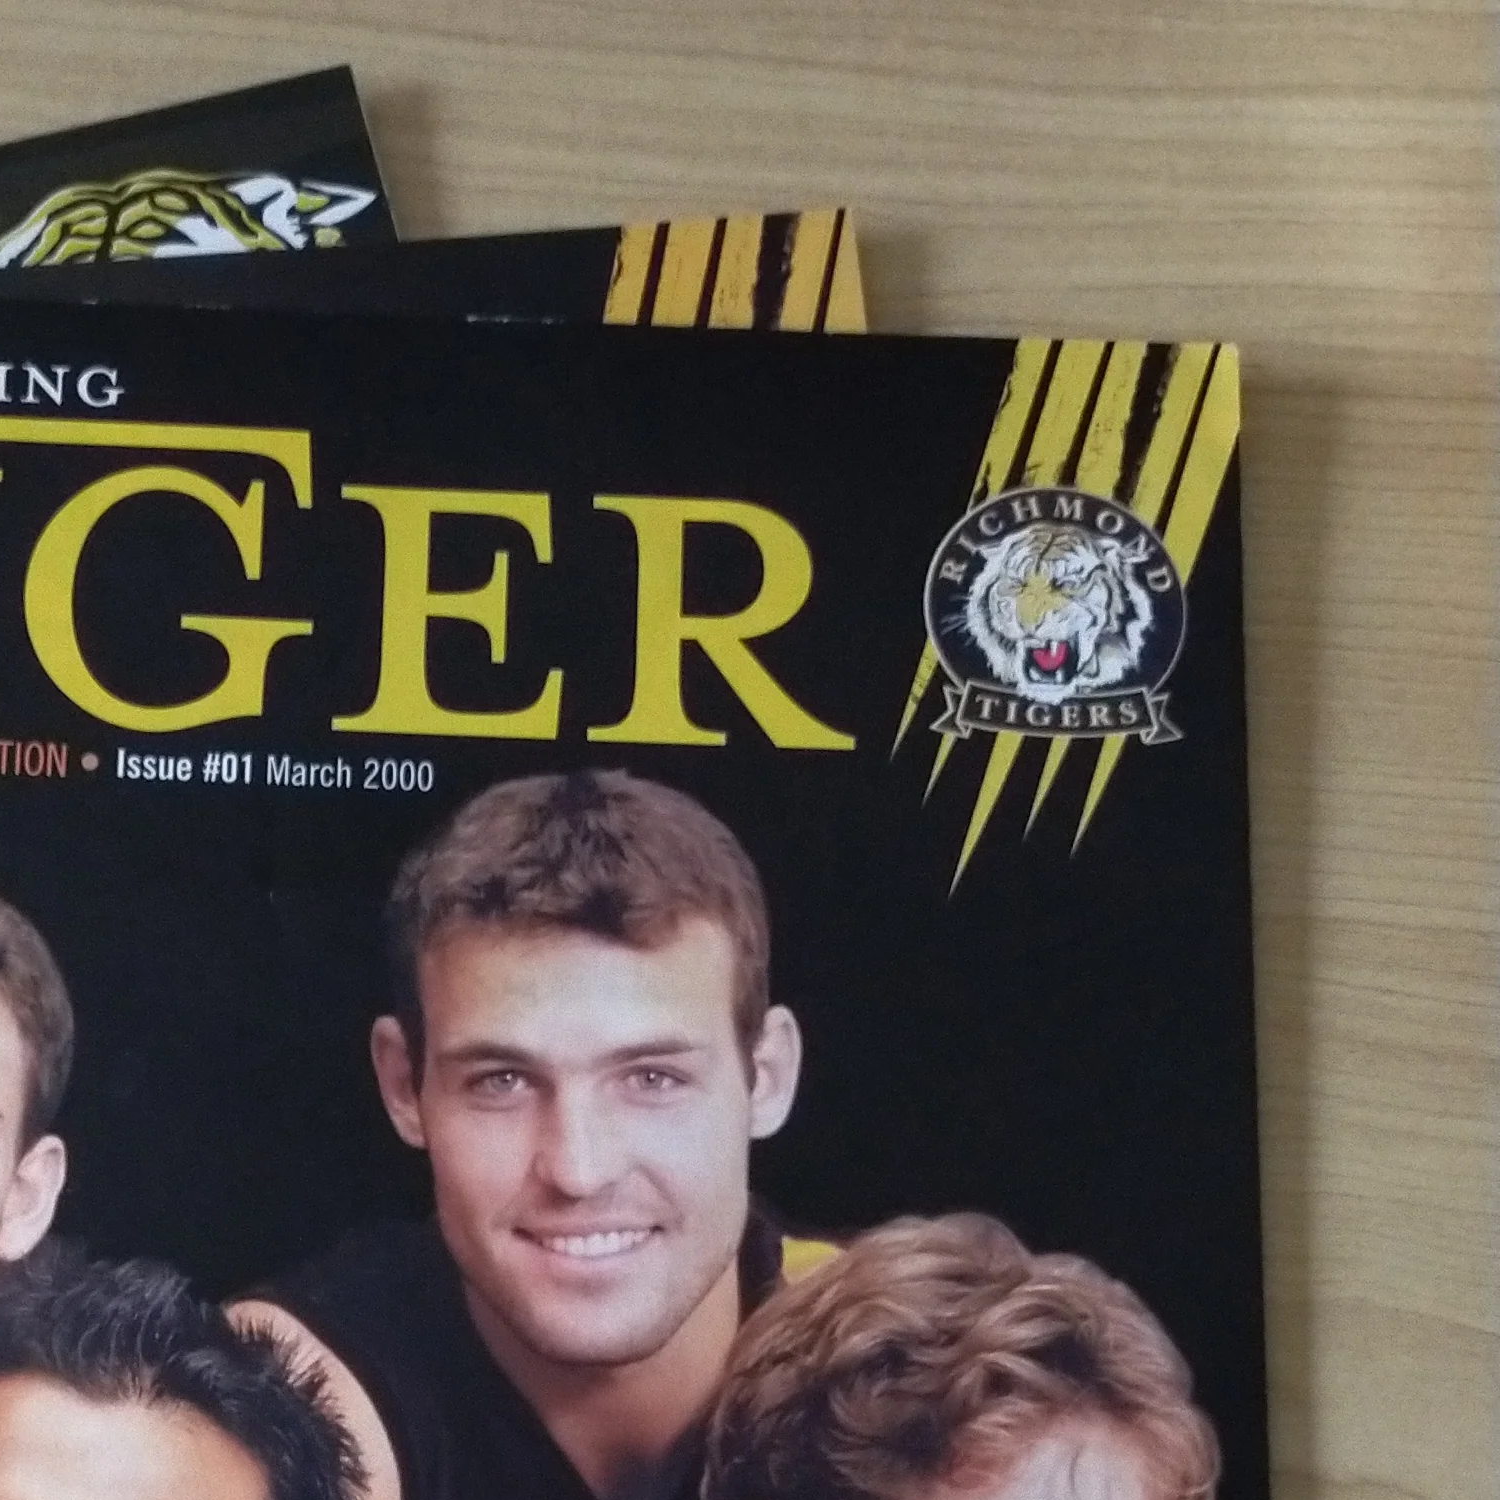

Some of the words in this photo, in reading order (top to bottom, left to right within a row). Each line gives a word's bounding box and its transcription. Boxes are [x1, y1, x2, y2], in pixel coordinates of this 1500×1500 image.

[939, 496, 1172, 593] RICHMOND
[975, 695, 1138, 728] TIGERS
[116, 747, 193, 782] Issue
[203, 753, 252, 784] #01
[266, 754, 351, 789] March
[363, 758, 434, 792] 2000
